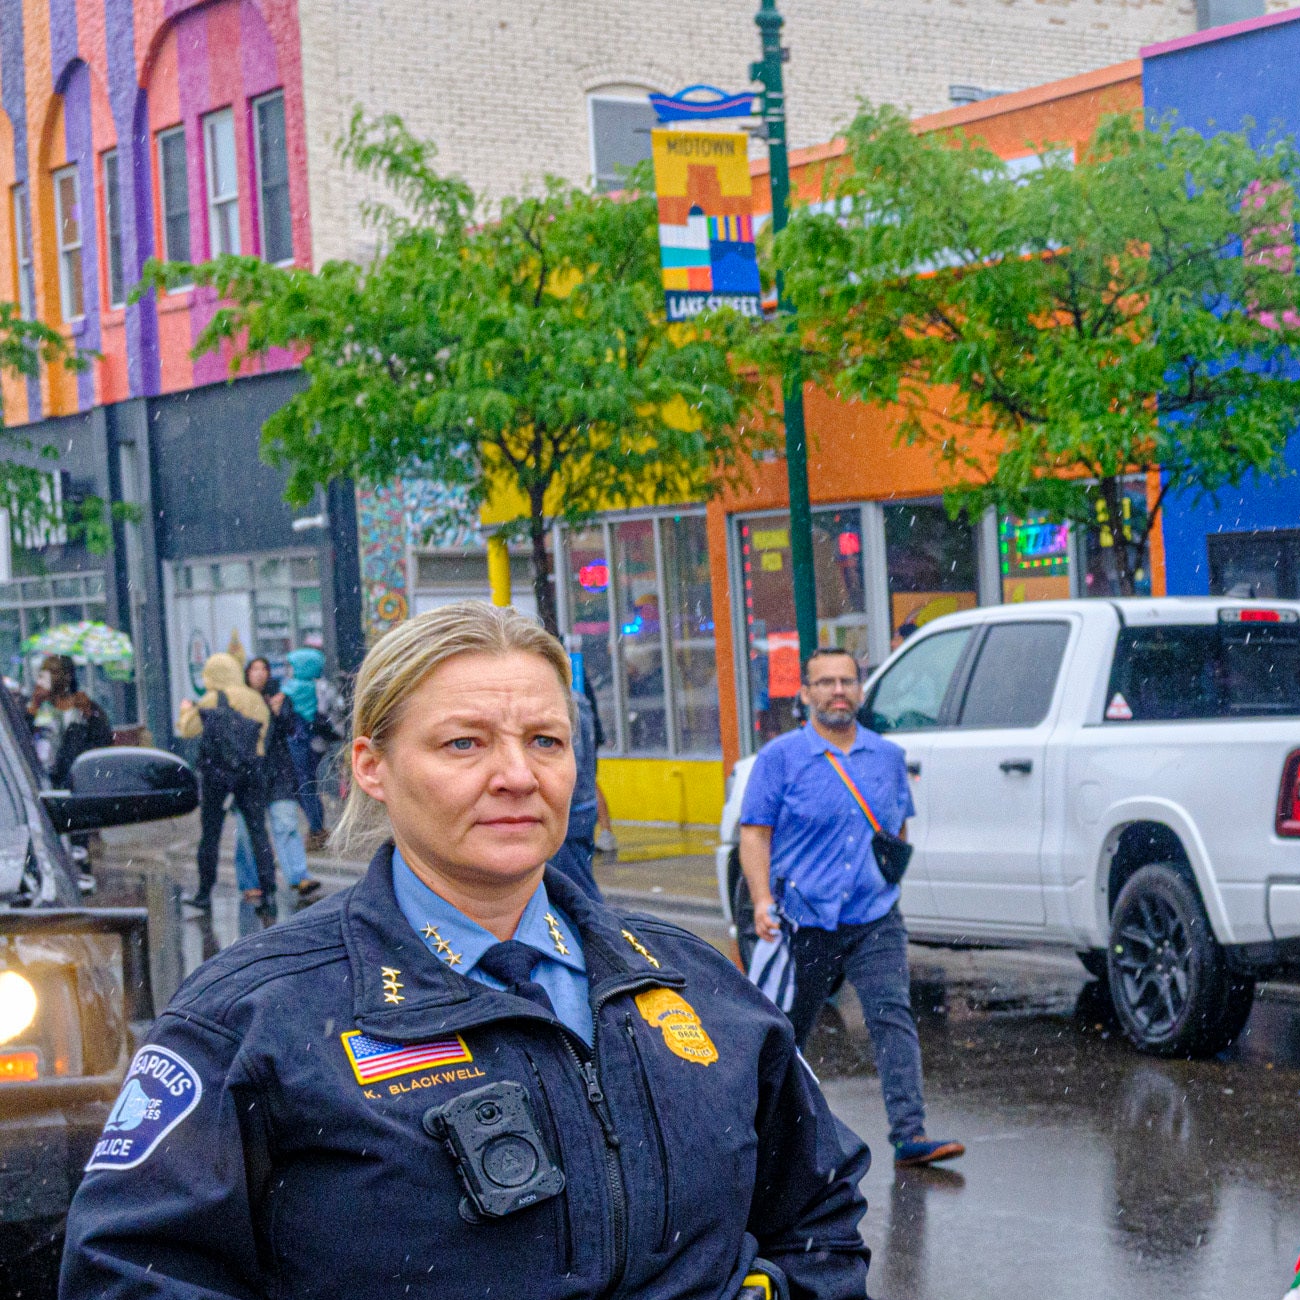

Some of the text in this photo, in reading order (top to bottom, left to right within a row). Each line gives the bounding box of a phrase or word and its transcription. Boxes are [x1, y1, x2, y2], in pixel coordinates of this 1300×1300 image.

[666, 137, 735, 157] MIDTOWN
[669, 297, 705, 318] LAKE
[134, 1054, 193, 1097] EAPOLIS
[363, 1066, 486, 1100] K. BLACKWELL
[148, 1098, 163, 1109] OF
